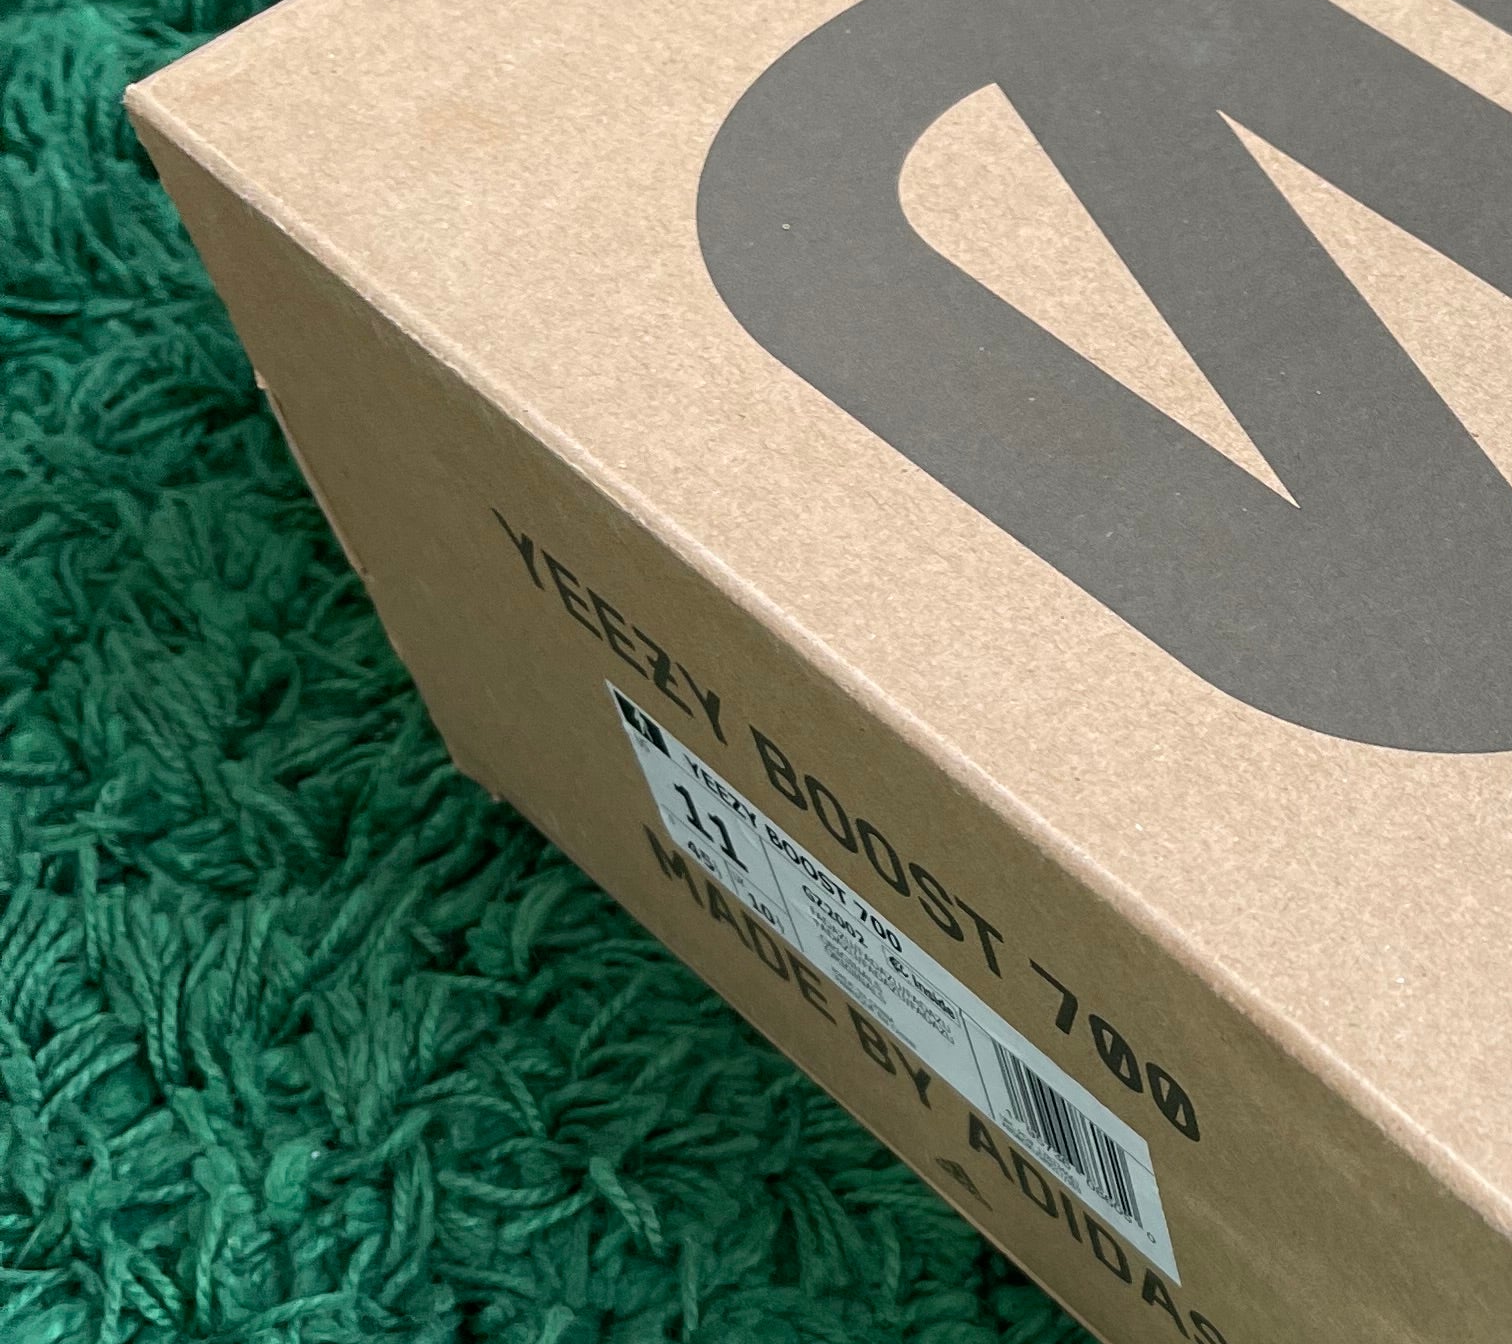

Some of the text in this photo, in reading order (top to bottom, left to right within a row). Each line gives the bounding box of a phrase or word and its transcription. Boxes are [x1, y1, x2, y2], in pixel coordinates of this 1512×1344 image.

[491, 507, 1201, 1141] YEEZY BOOST 700
[674, 783, 748, 873] 11
[684, 754, 902, 953] YEEZY BOOST 700
[802, 885, 868, 949] GZ2002
[642, 824, 838, 1027] MADE
[848, 1002, 936, 1110] BY
